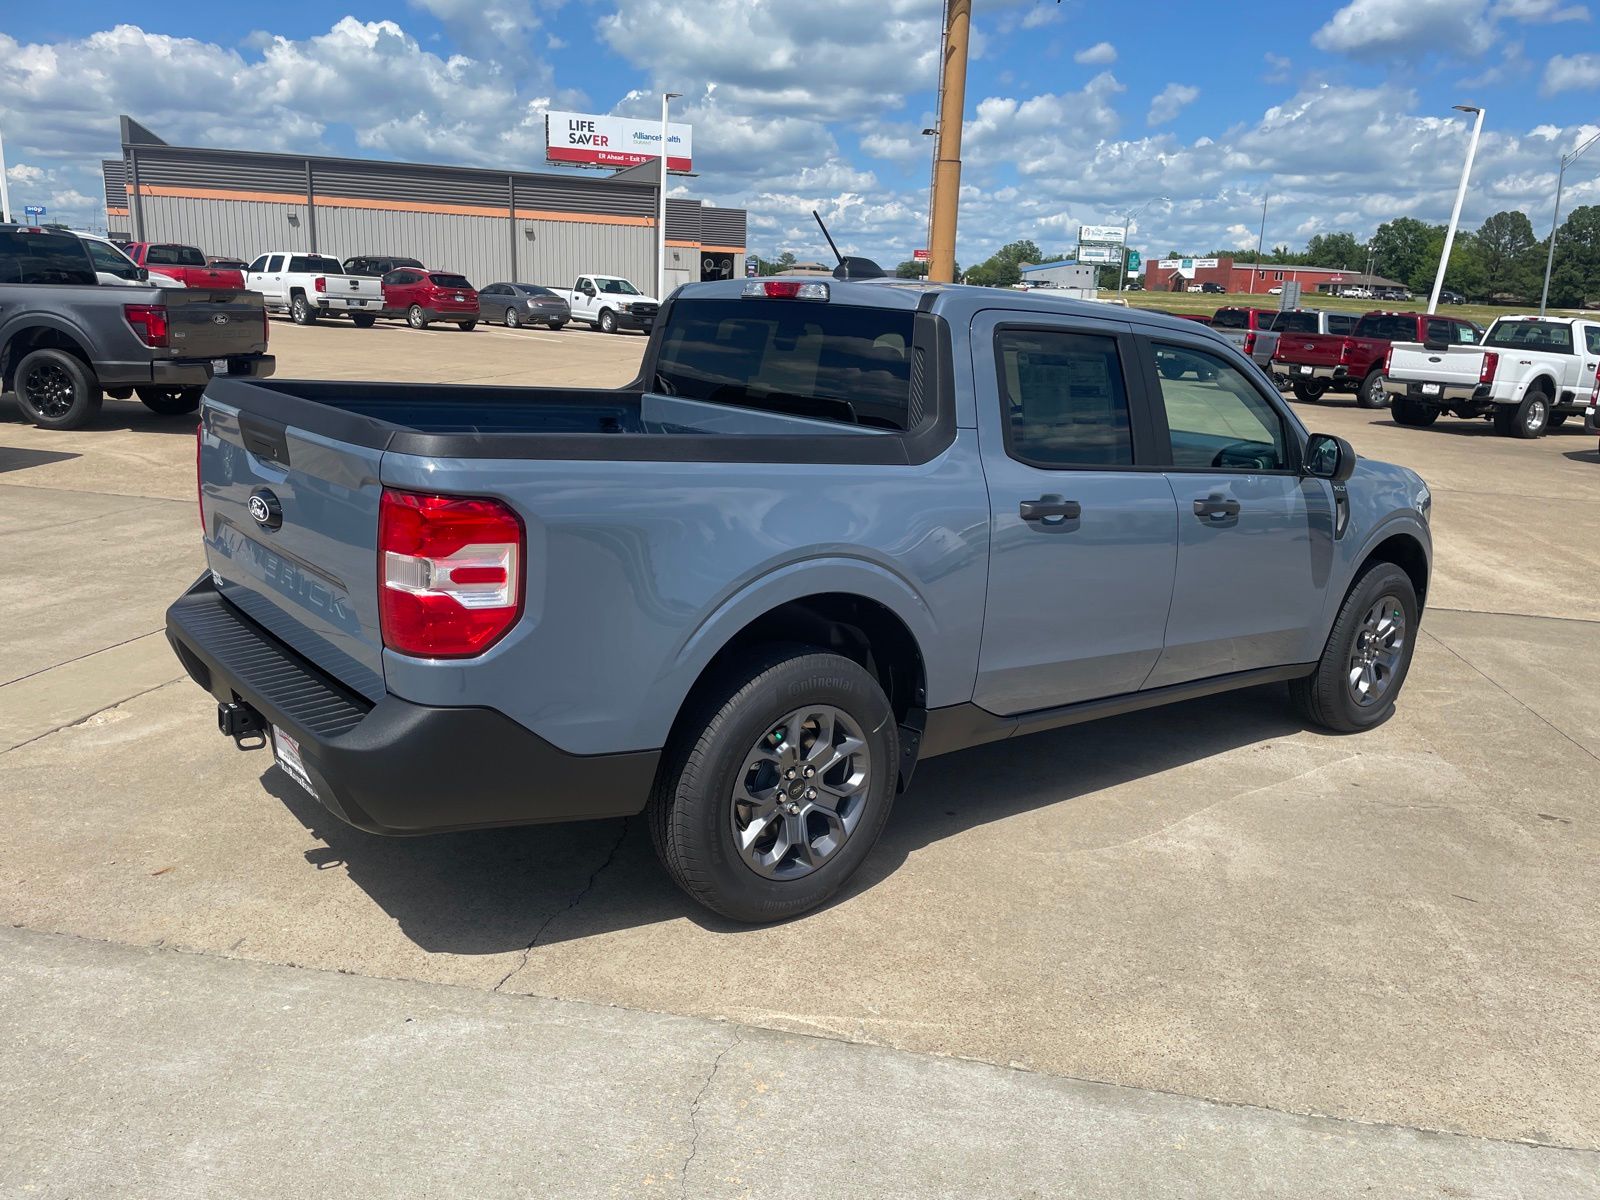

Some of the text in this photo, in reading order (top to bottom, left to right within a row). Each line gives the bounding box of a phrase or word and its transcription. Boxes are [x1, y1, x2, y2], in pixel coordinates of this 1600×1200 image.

[569, 119, 595, 132] LIFE
[569, 132, 609, 147] SAVER
[598, 152, 606, 160] ER
[607, 153, 625, 161] Ahead
[249, 497, 267, 520] Ford
[221, 523, 347, 620] MAVERICK
